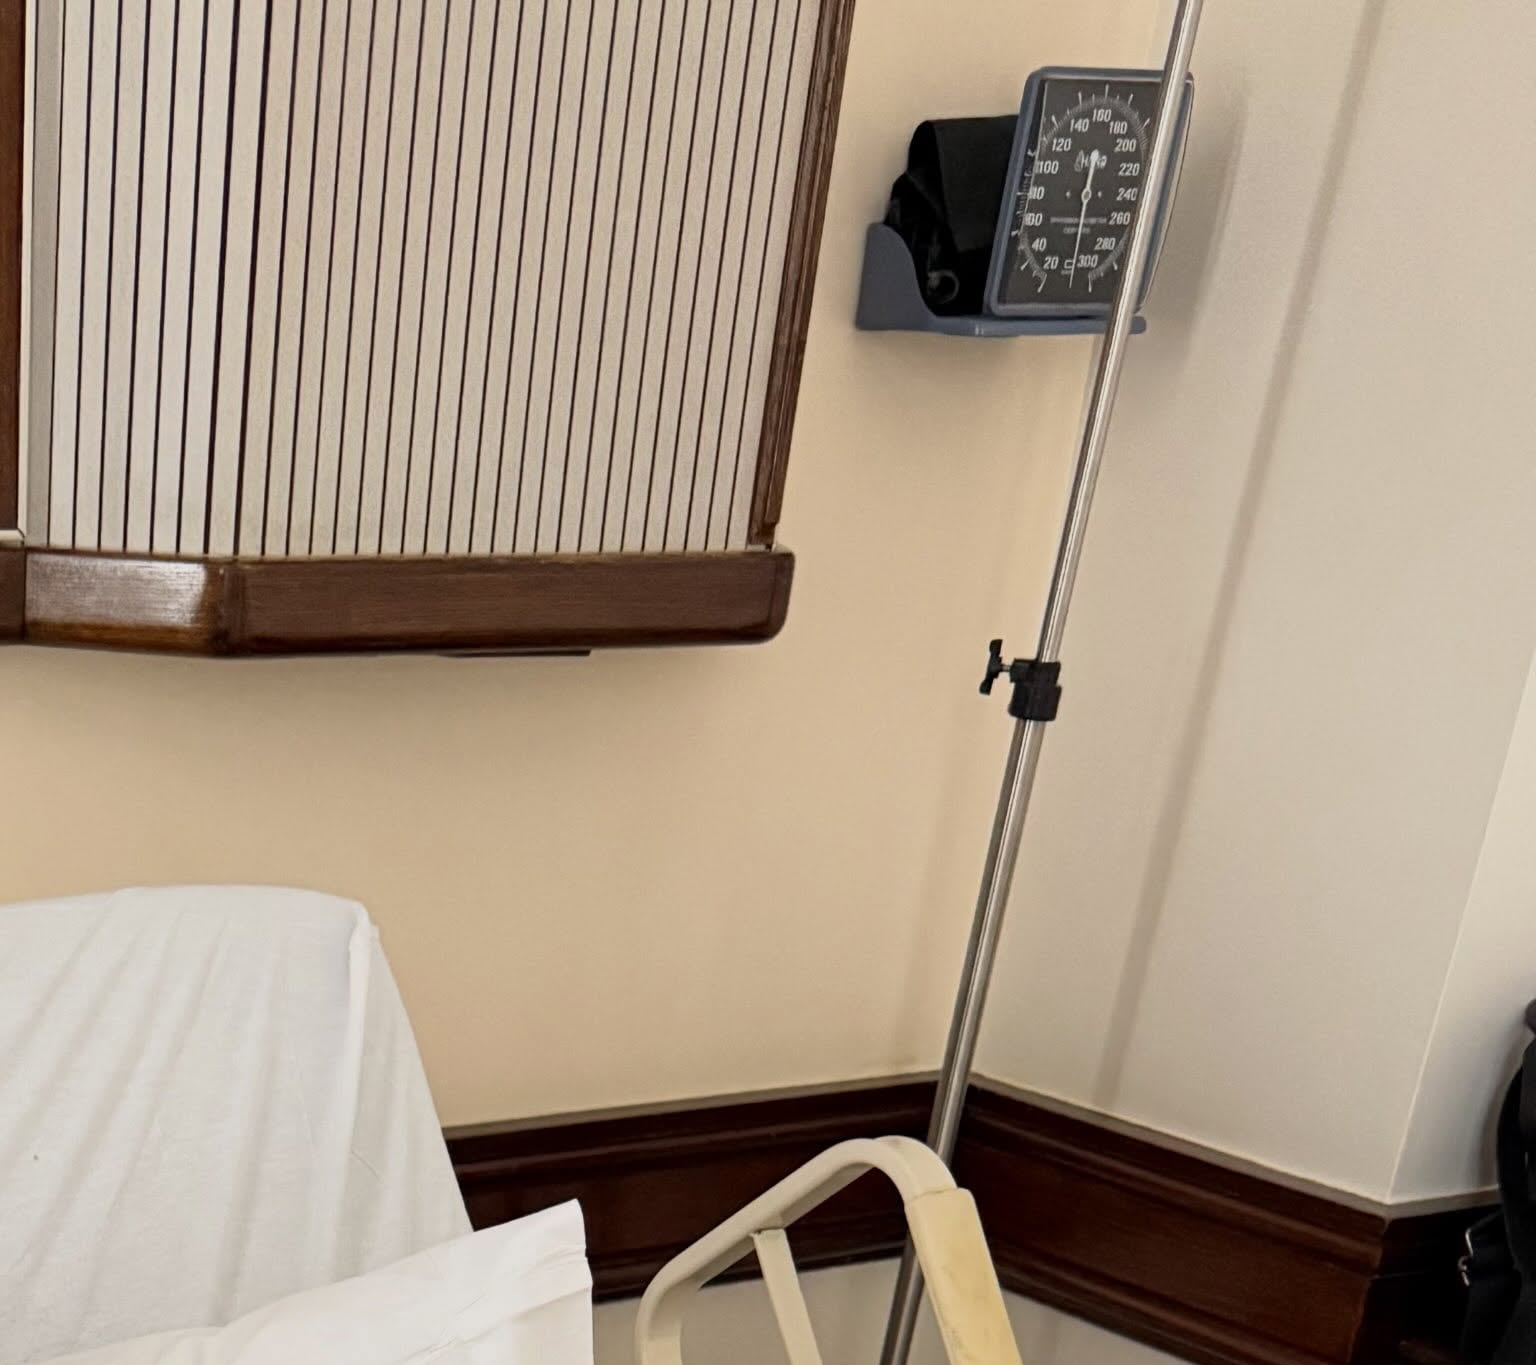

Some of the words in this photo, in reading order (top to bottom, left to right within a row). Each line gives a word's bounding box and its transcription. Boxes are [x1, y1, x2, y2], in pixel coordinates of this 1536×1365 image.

[1069, 118, 1090, 133] 140
[1052, 138, 1072, 152] 120
[1114, 138, 1137, 152] 200
[1118, 163, 1140, 177] 220
[1116, 187, 1138, 201] 240
[1109, 212, 1131, 226] 260
[1032, 238, 1047, 252] 40
[1044, 256, 1059, 270] 20
[1077, 255, 1098, 269] 300
